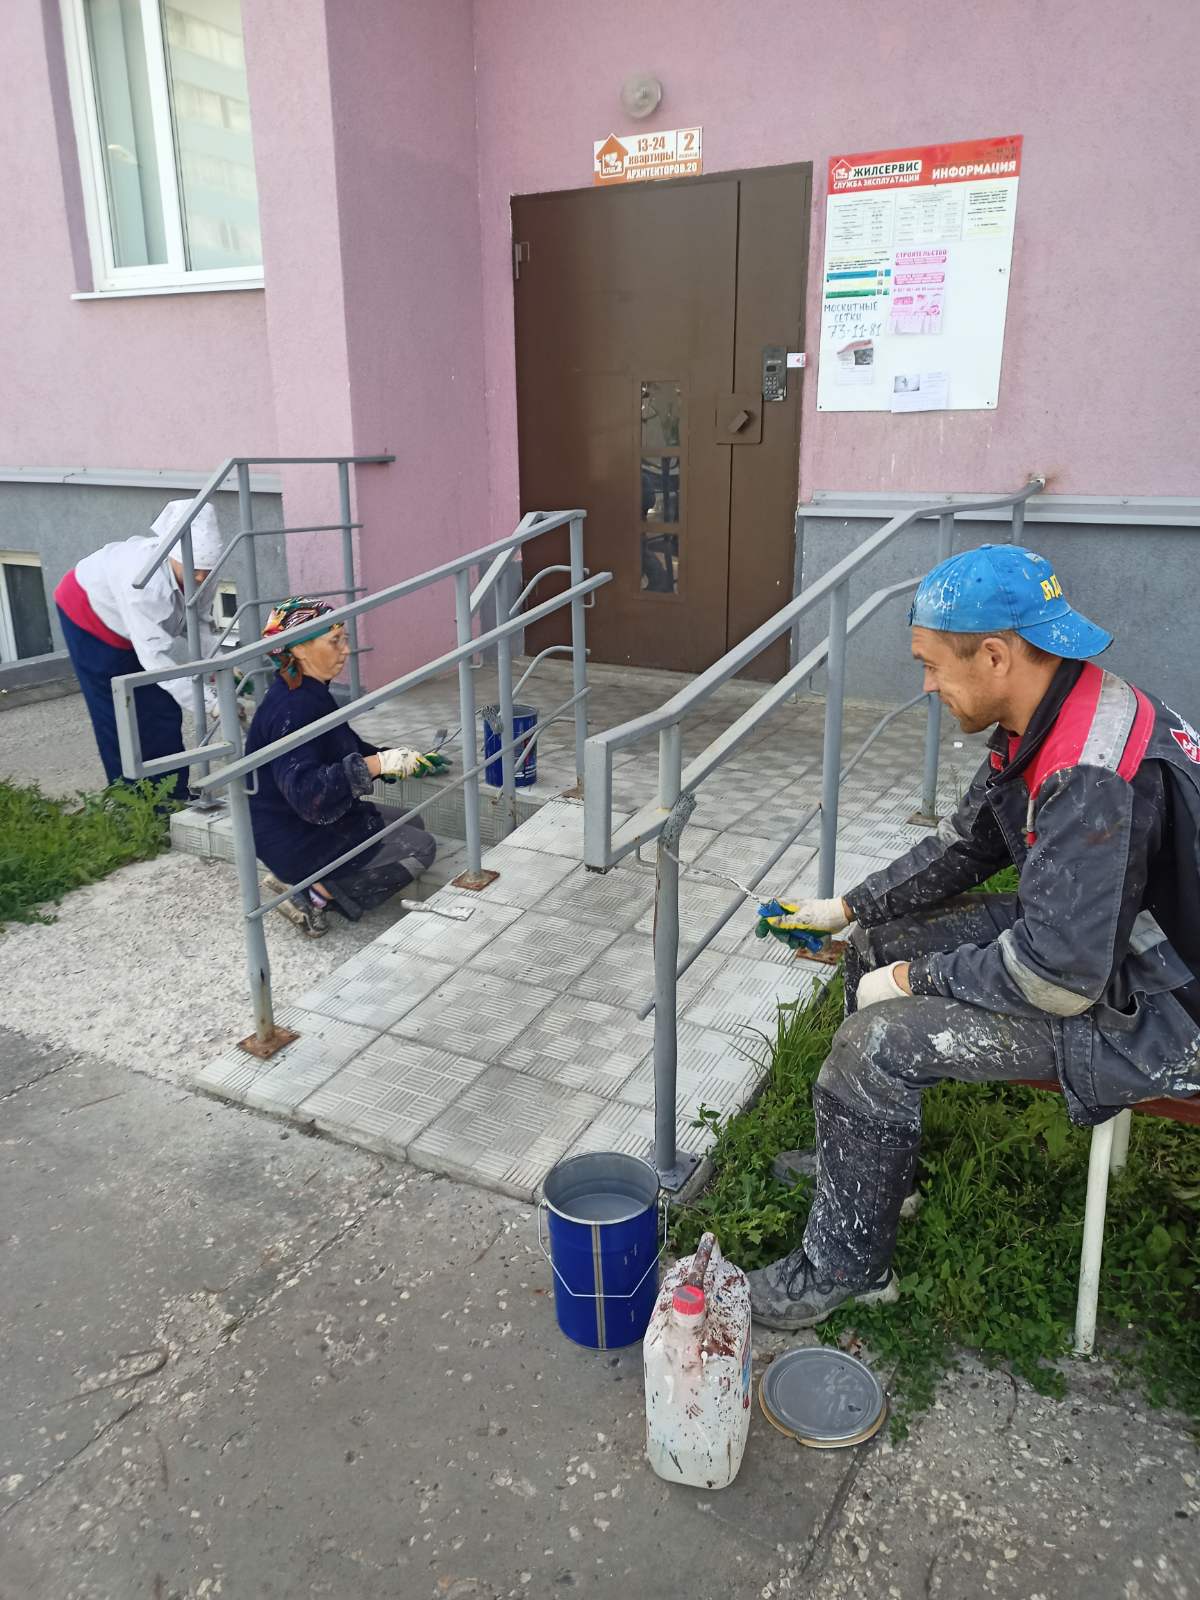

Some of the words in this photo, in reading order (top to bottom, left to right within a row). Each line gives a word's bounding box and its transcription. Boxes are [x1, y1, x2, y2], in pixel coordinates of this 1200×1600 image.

[638, 136, 666, 152] 13-24
[684, 132, 695, 151] 2
[629, 150, 674, 165] квартиры
[853, 162, 919, 177] ЖИЛСЕРВИС
[932, 160, 1016, 180] ИНФОРМАЦИЯ
[833, 181, 863, 189] СЛУЖБА
